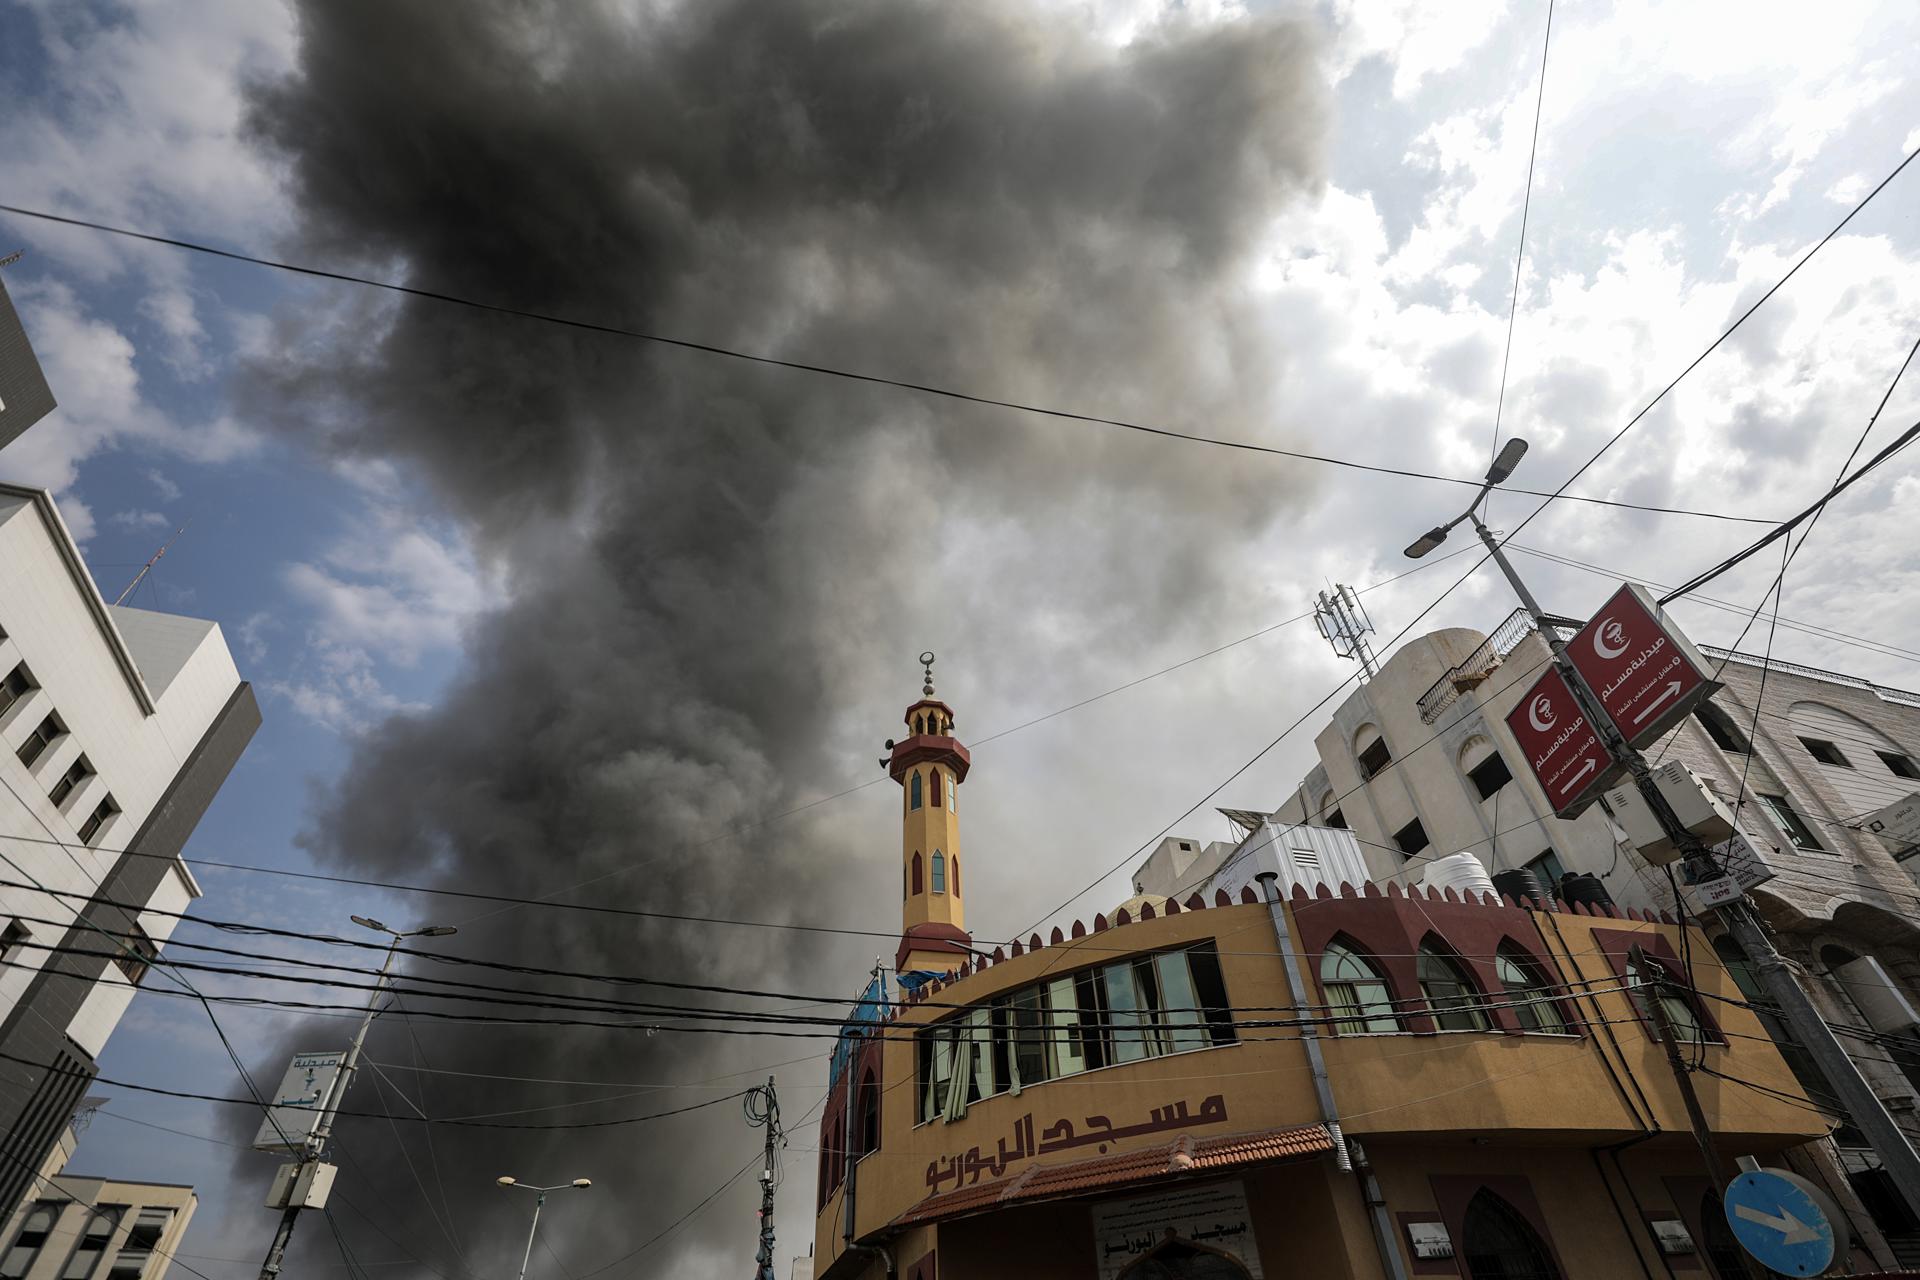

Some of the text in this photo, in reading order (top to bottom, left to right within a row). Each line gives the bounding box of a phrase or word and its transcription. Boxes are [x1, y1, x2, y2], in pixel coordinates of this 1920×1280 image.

[1601, 637, 1665, 702] صيدلية مسلم
[1657, 663, 1674, 680] مقابل
[1616, 699, 1633, 717] الشفاء
[1535, 716, 1584, 772] صيدلية مسلم
[294, 1059, 337, 1070] صيدلية
[925, 1094, 1228, 1199] مسجد البورنو
[1103, 1221, 1248, 1258] مسجد البورنو
